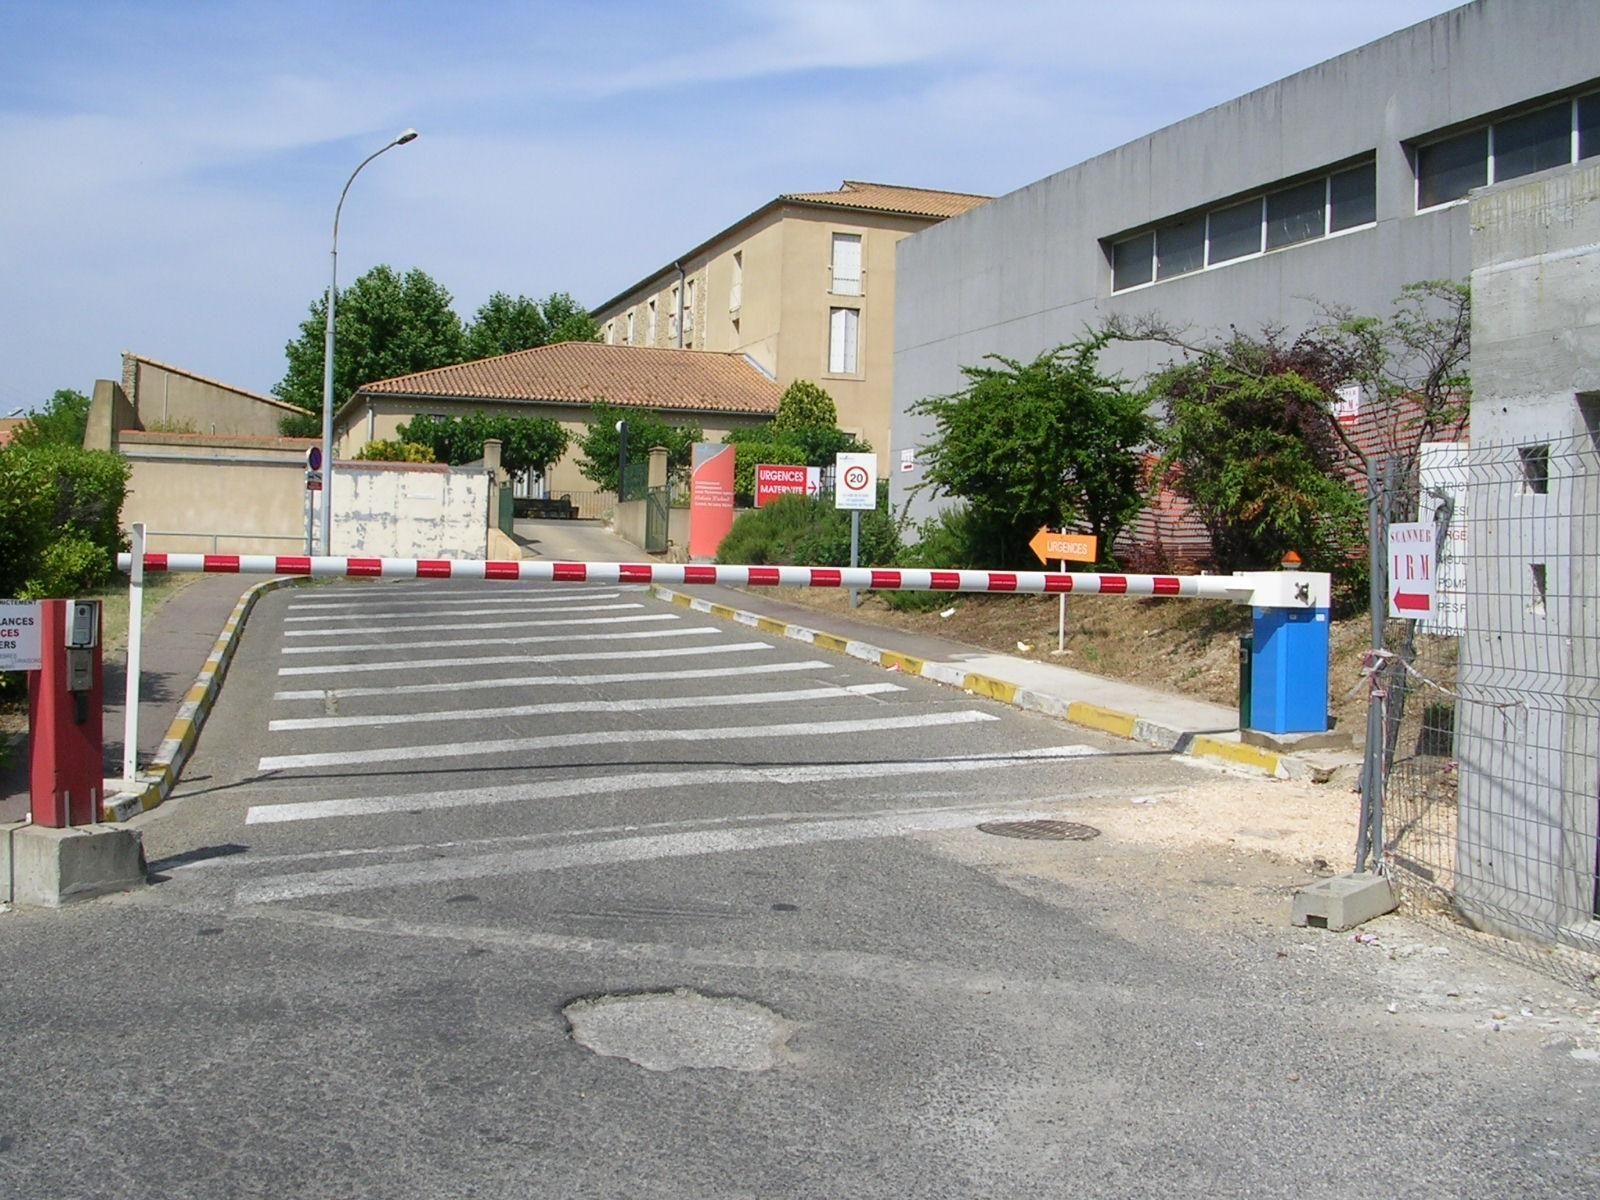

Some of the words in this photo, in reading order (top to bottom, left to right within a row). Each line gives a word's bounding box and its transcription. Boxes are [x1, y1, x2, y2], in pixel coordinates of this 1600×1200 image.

[760, 469, 804, 482] URGENCES
[850, 473, 864, 483] 20
[1390, 529, 1431, 543] SCANNER
[1047, 541, 1088, 555] URGENCES
